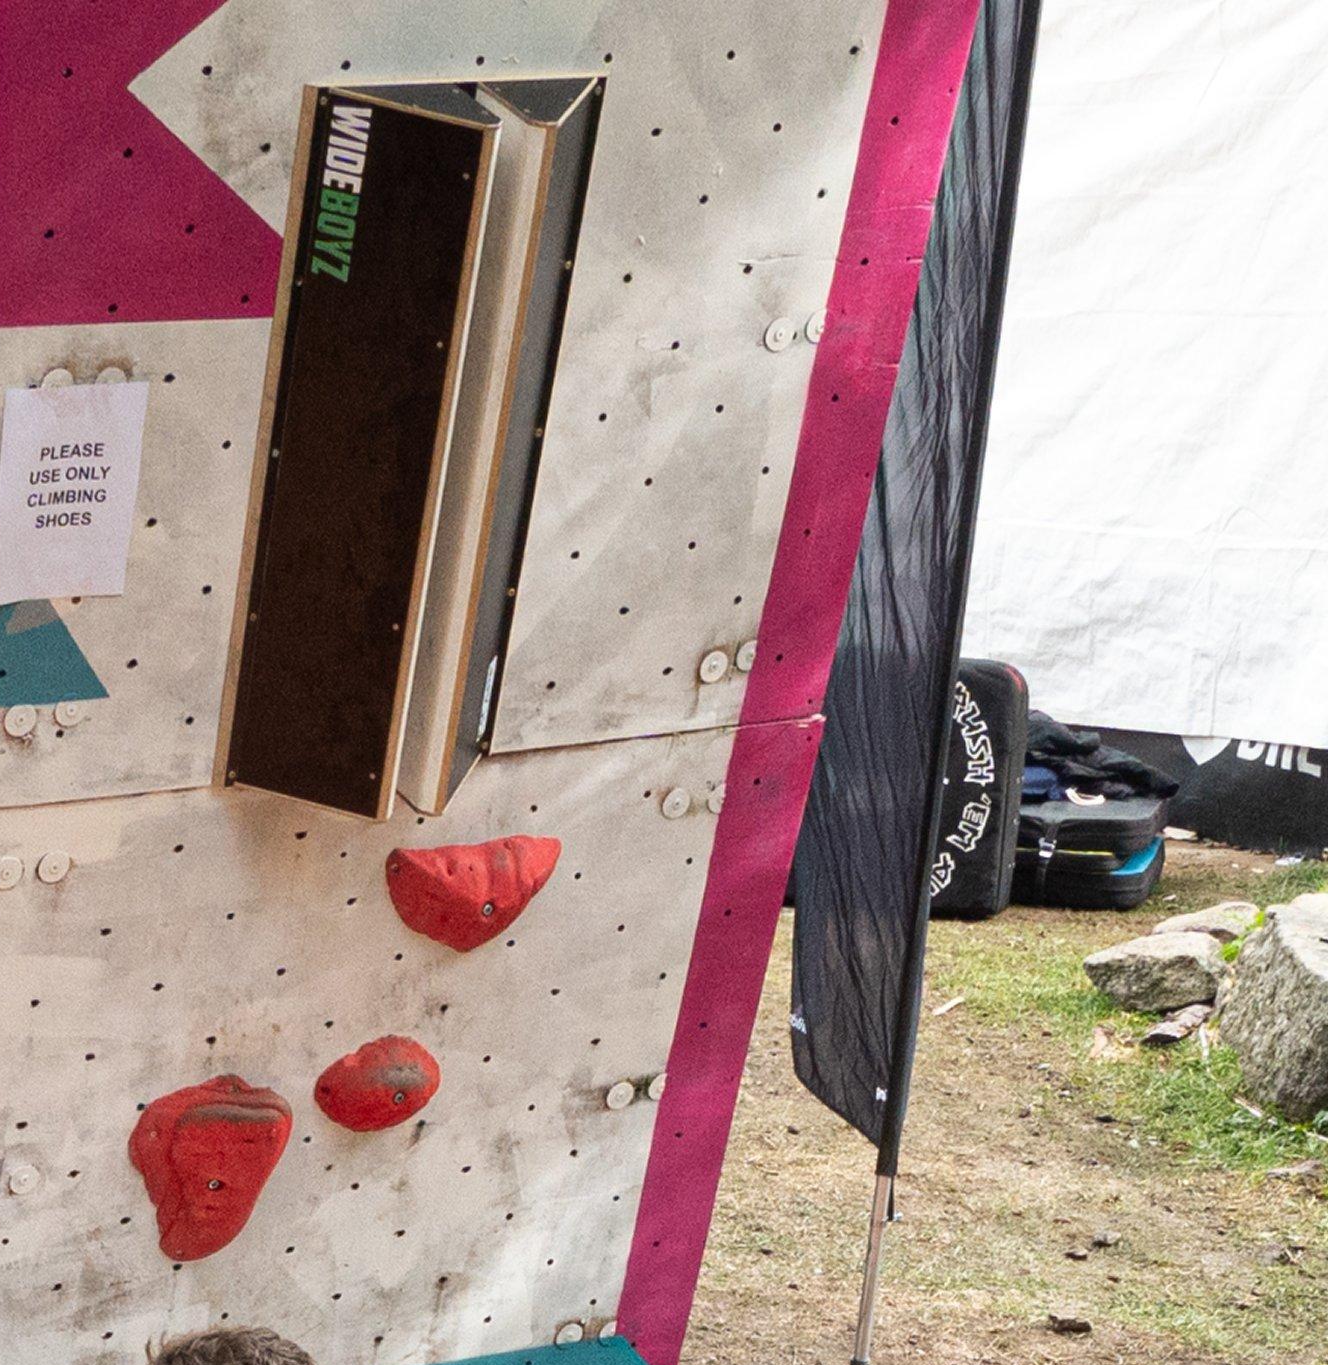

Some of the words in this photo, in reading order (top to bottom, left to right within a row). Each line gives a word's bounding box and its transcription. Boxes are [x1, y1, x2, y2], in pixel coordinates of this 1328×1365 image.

[311, 105, 372, 282] WIDEBOYZ
[40, 443, 104, 461] PLEASE
[30, 469, 60, 485] USE
[66, 466, 110, 480] ONLY
[27, 489, 107, 508] CLIMBING
[35, 511, 91, 529] SHOES
